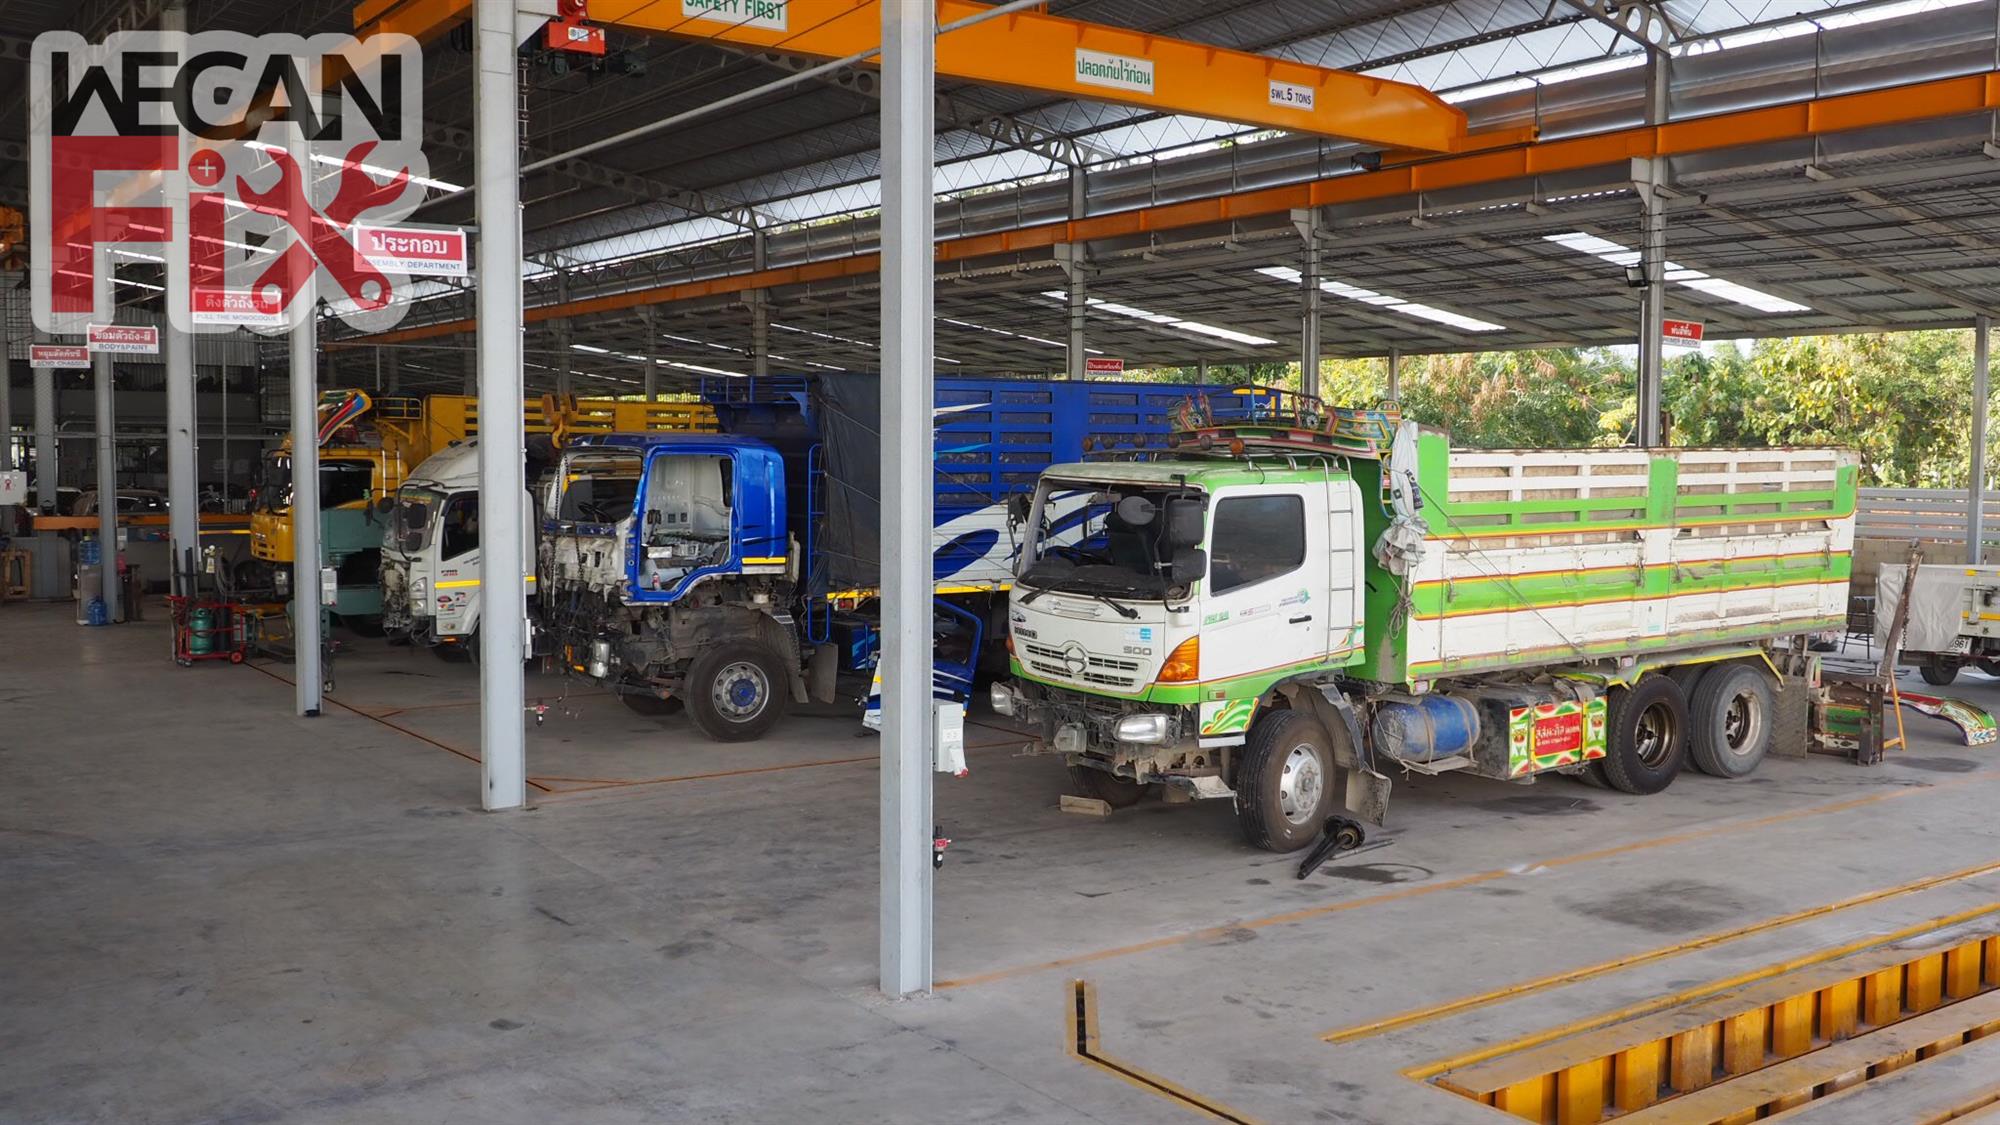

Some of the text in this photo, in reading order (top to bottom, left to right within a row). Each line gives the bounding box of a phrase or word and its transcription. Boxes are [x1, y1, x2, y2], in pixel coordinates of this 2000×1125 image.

[744, 0, 782, 20] FIRST
[1078, 57, 1150, 85] ปลอดภัยไว้ก่อน
[1295, 92, 1312, 105] TONS
[371, 232, 448, 254] ประกอบ
[361, 259, 461, 271] ASSEMBLY DEPARTMENT
[98, 343, 149, 351] BODY&PAINT
[1123, 645, 1152, 656] 500
